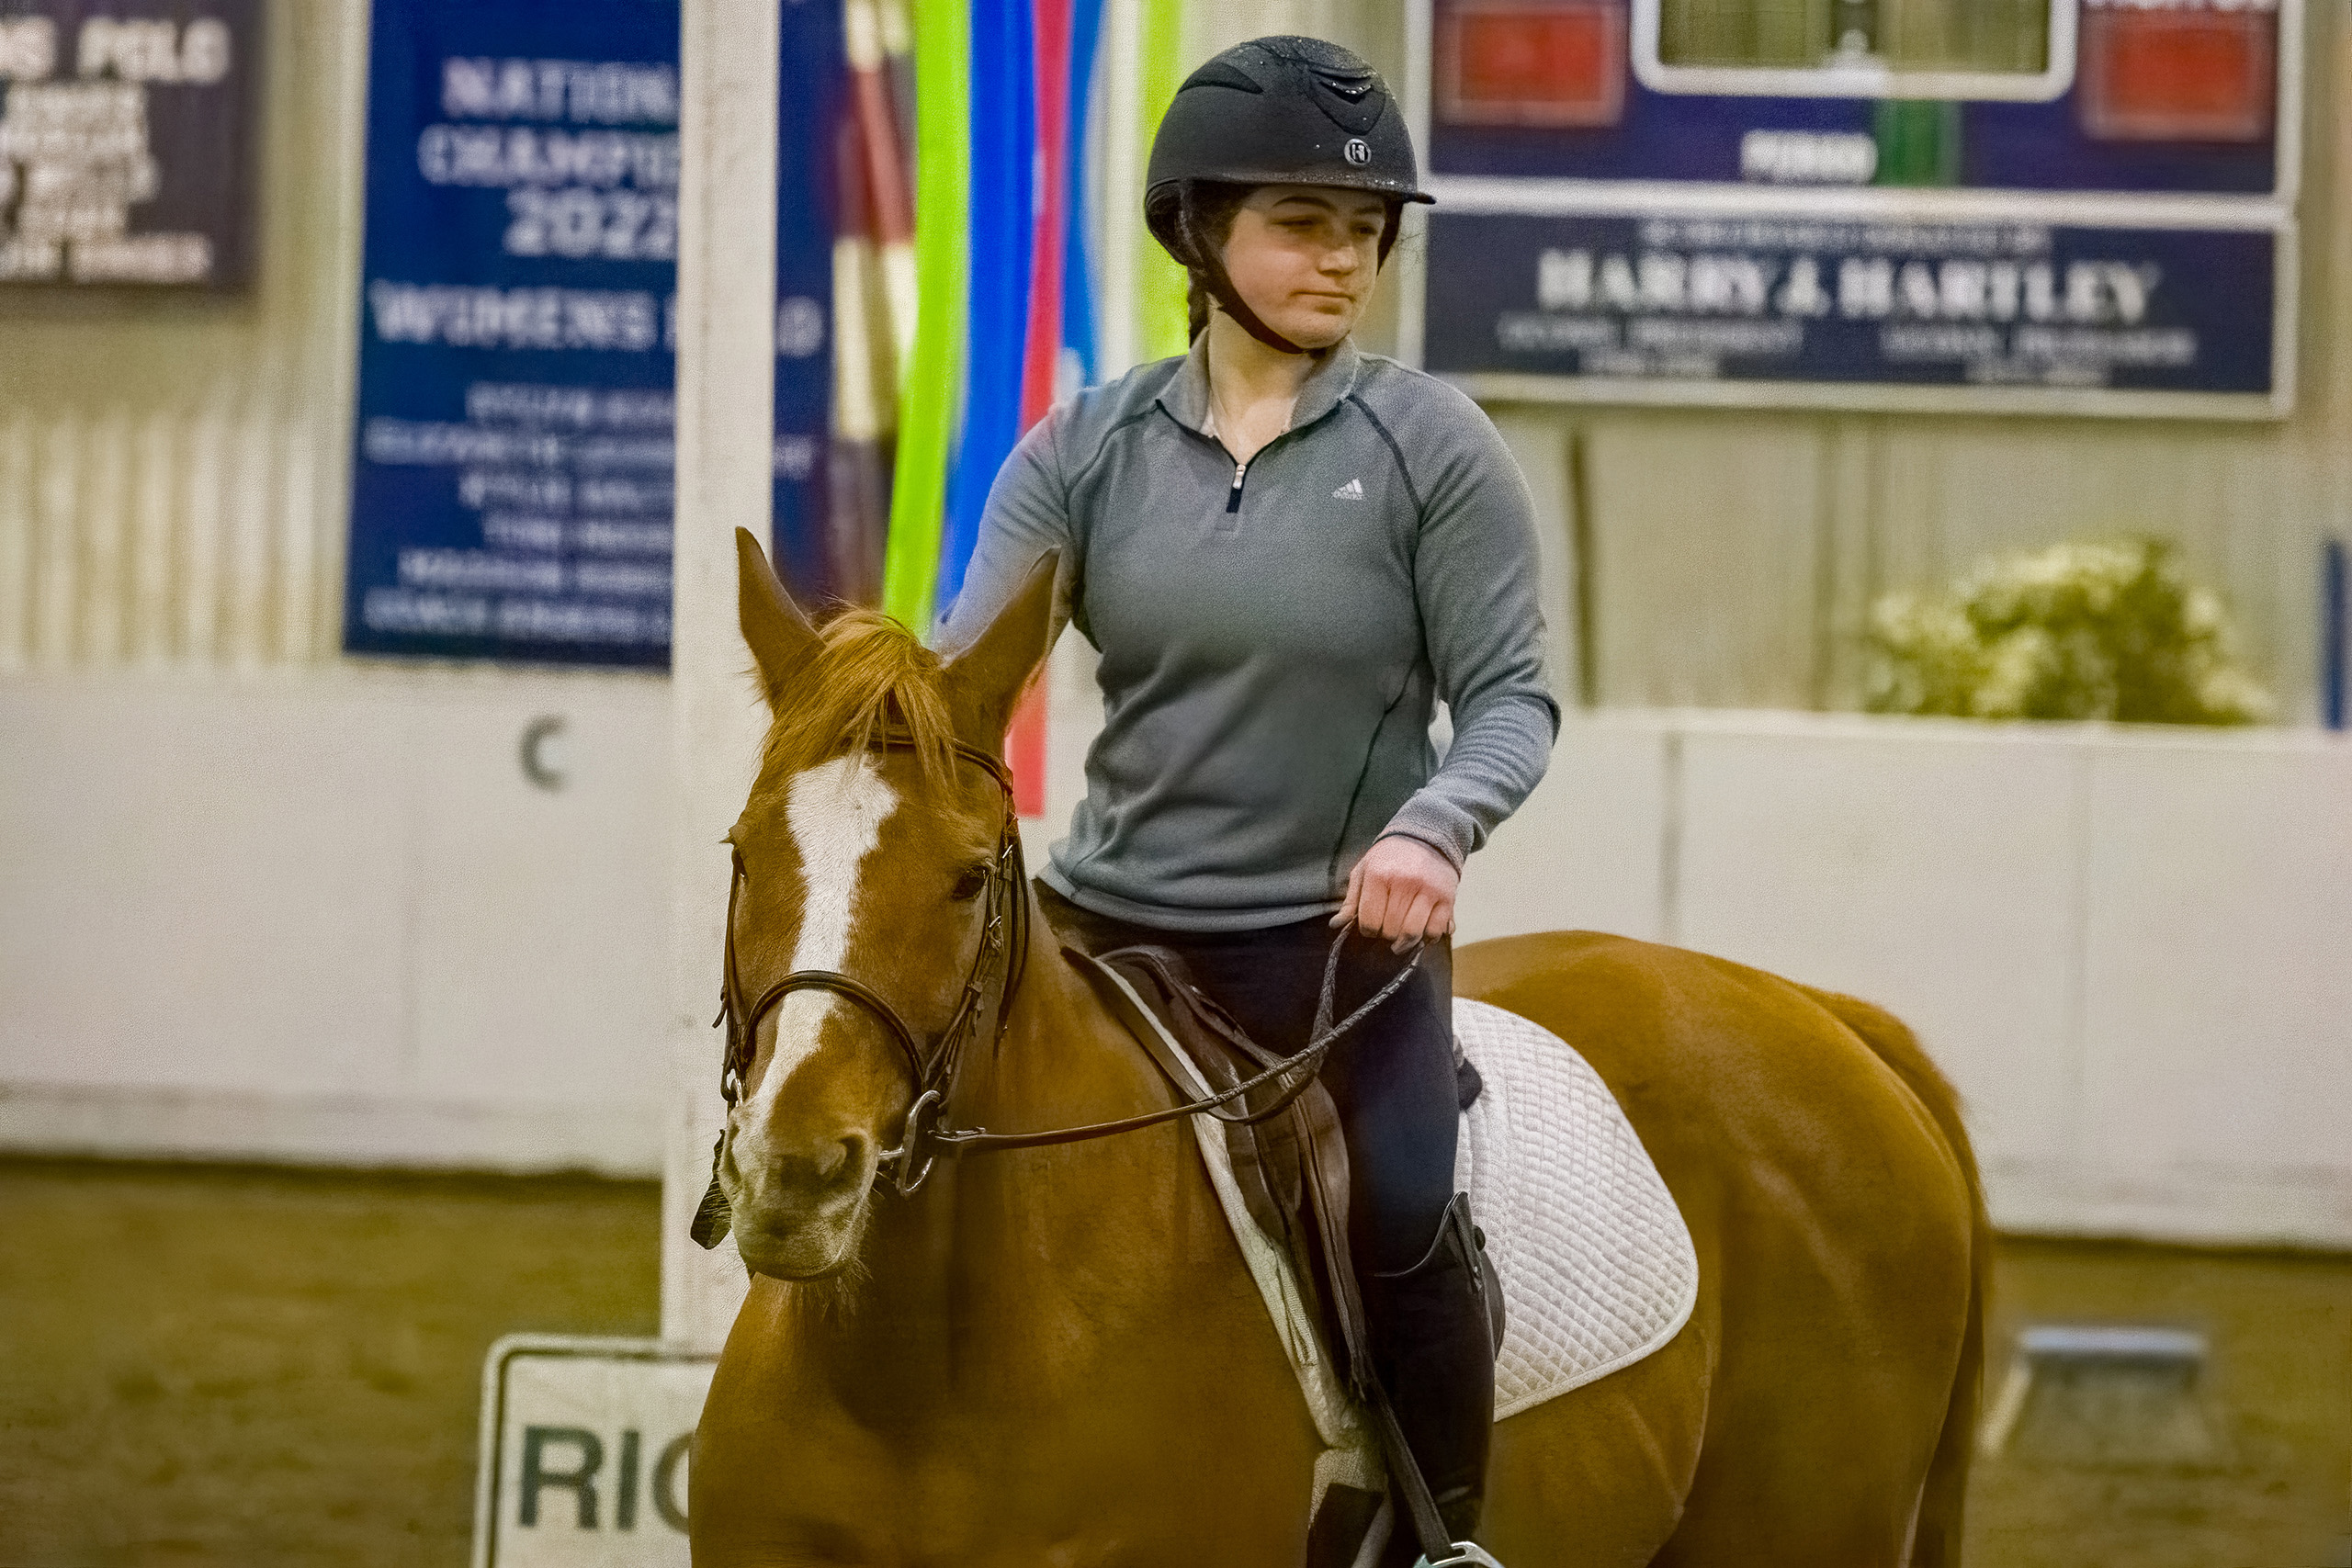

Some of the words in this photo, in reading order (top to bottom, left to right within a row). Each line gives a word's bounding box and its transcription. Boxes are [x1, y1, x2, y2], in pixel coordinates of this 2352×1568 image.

[77, 17, 231, 85] POLO
[503, 186, 678, 259] 2022
[1537, 248, 1781, 317] HARRY
[1838, 255, 2159, 323] HARTLEY
[520, 714, 567, 797] C
